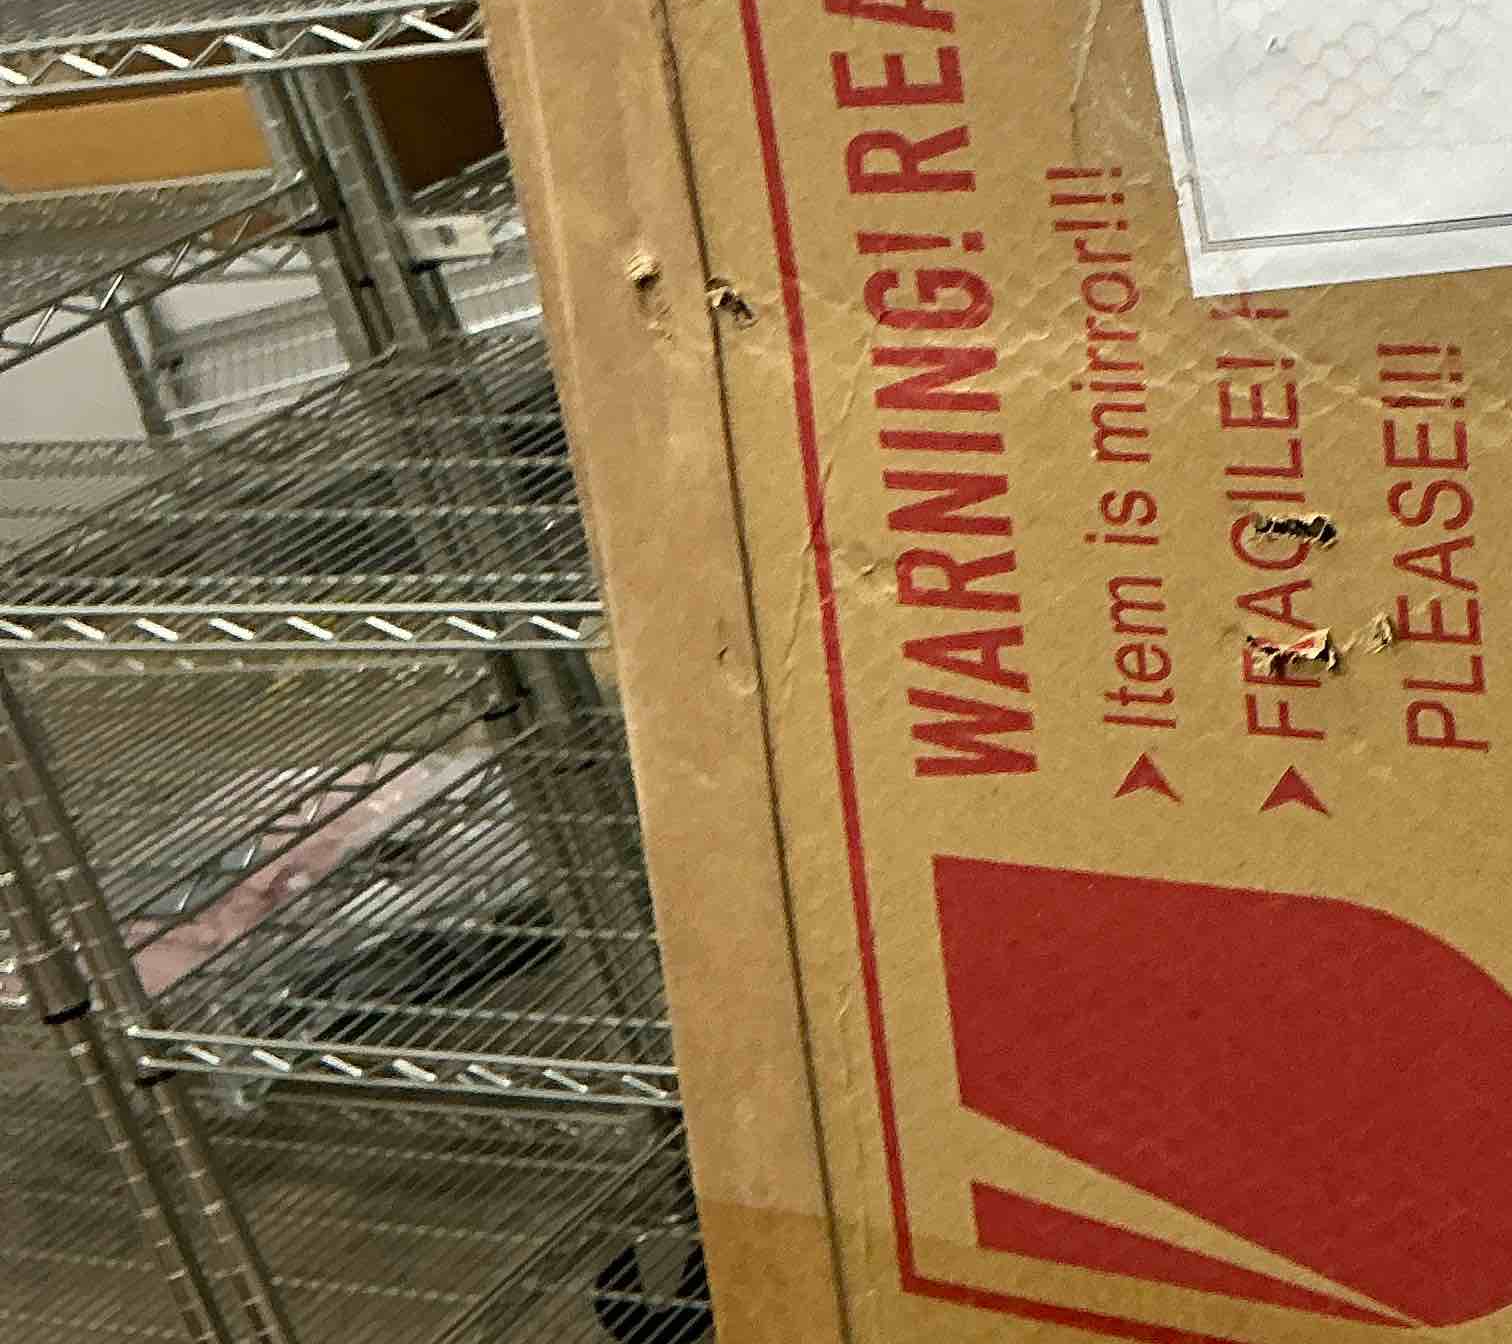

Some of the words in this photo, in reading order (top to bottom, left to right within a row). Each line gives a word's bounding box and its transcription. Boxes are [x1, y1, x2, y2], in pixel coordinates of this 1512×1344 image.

[1045, 167, 1151, 463] mirror!!!
[857, 231, 1038, 778] WARNING!
[1085, 492, 1158, 545] is
[1103, 572, 1178, 729] Item
[1377, 343, 1490, 753] PLEASE!!!
